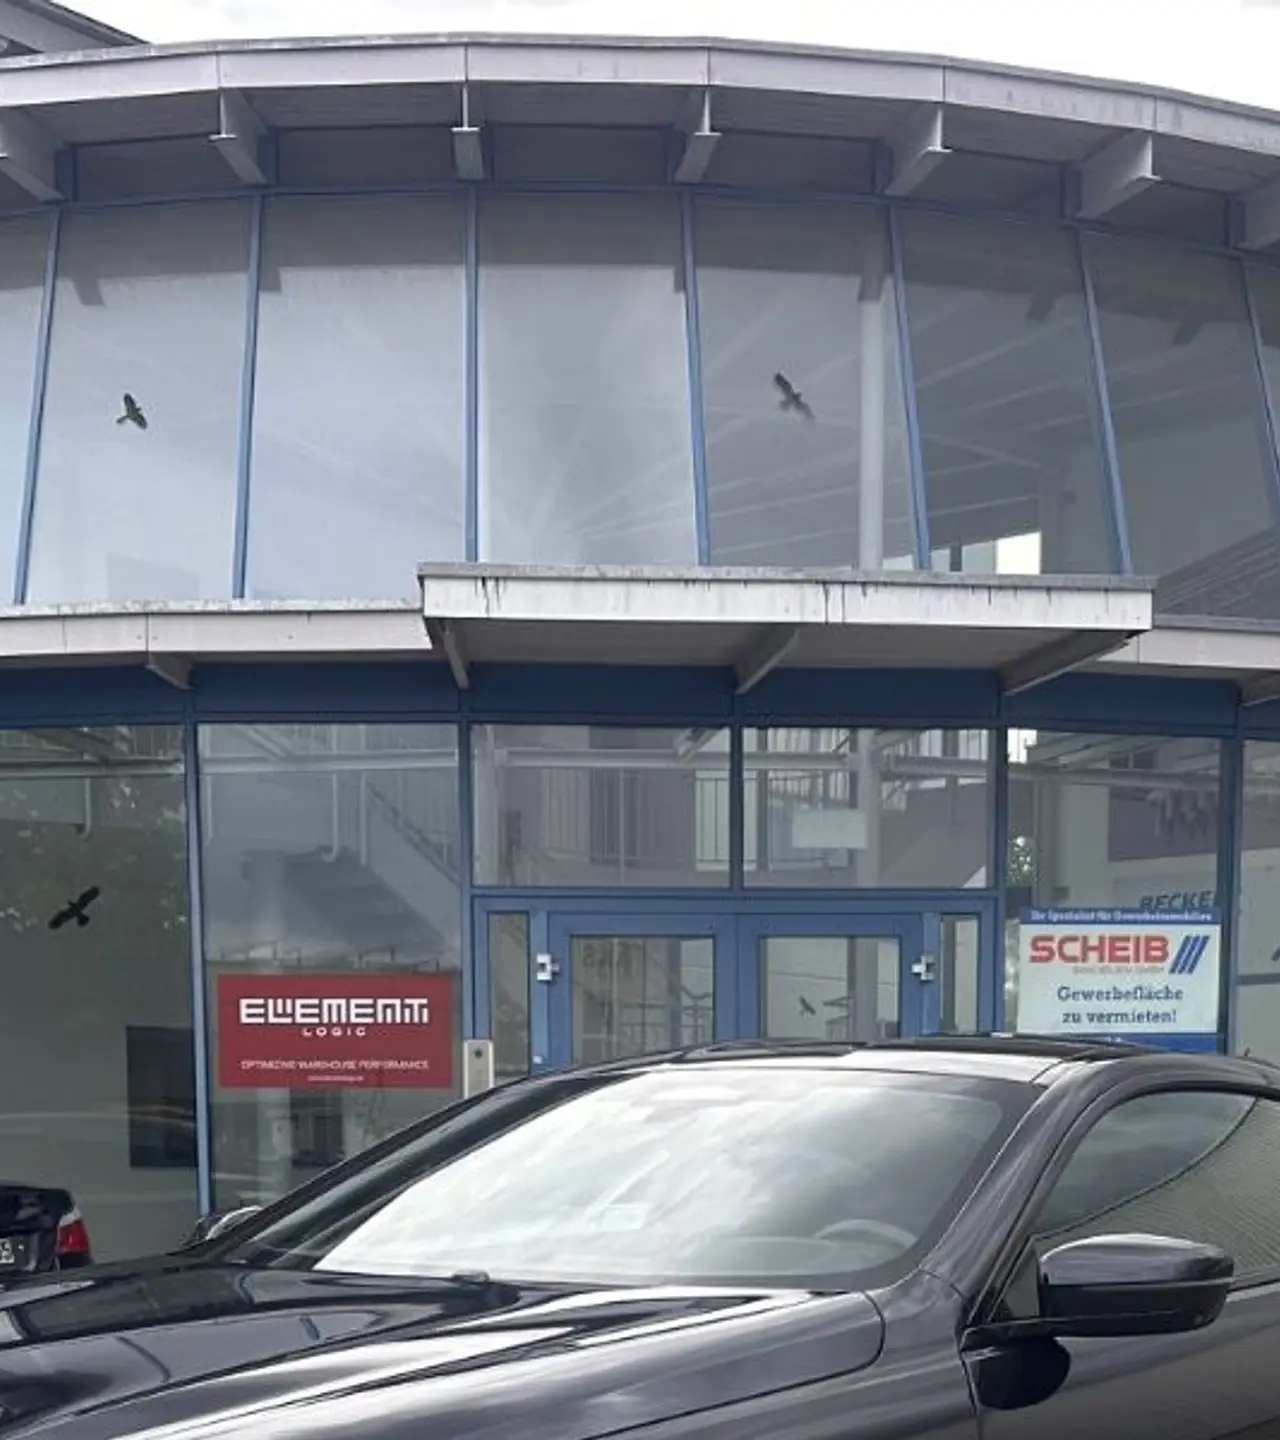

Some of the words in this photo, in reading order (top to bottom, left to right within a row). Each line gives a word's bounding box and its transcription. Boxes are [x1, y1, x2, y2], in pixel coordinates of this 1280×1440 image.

[1029, 934, 1169, 963] SCHEIB
[1057, 984, 1183, 1001] Gewerbefläche
[239, 998, 429, 1024] ELEMENT
[1062, 1012, 1081, 1023] zu
[1086, 1008, 1176, 1023] vermieten!
[302, 1027, 366, 1037] LOGIC
